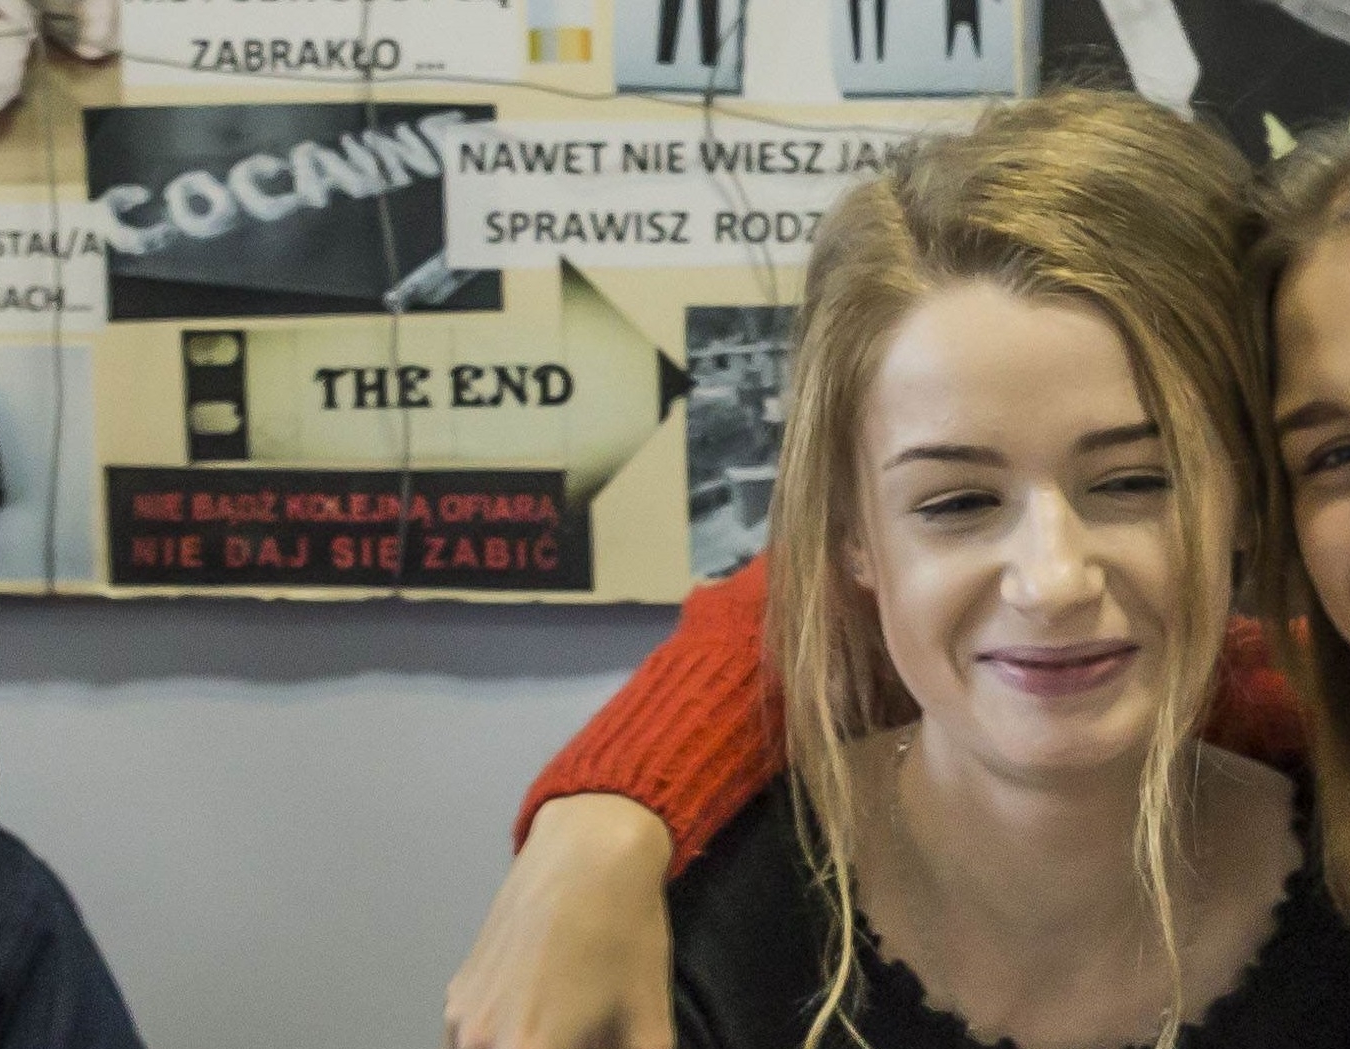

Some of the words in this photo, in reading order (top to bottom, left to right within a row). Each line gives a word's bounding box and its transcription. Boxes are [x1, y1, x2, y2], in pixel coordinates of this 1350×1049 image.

[189, 38, 401, 73] ZABRAKŁO
[458, 140, 608, 174] NAWET
[621, 141, 688, 174] NIE
[698, 141, 827, 175] WIESZ
[484, 210, 691, 244] SPRAWISZ
[314, 364, 432, 409] THE
[449, 363, 575, 407] END
[132, 491, 184, 522] NIE
[190, 490, 280, 525] BĄDŹ
[285, 492, 432, 528] KOLEJNĄ
[132, 535, 202, 567] NIE
[224, 535, 309, 568] DAJ
[330, 535, 402, 571] SIĘ
[422, 532, 559, 569] ZABIĆ
